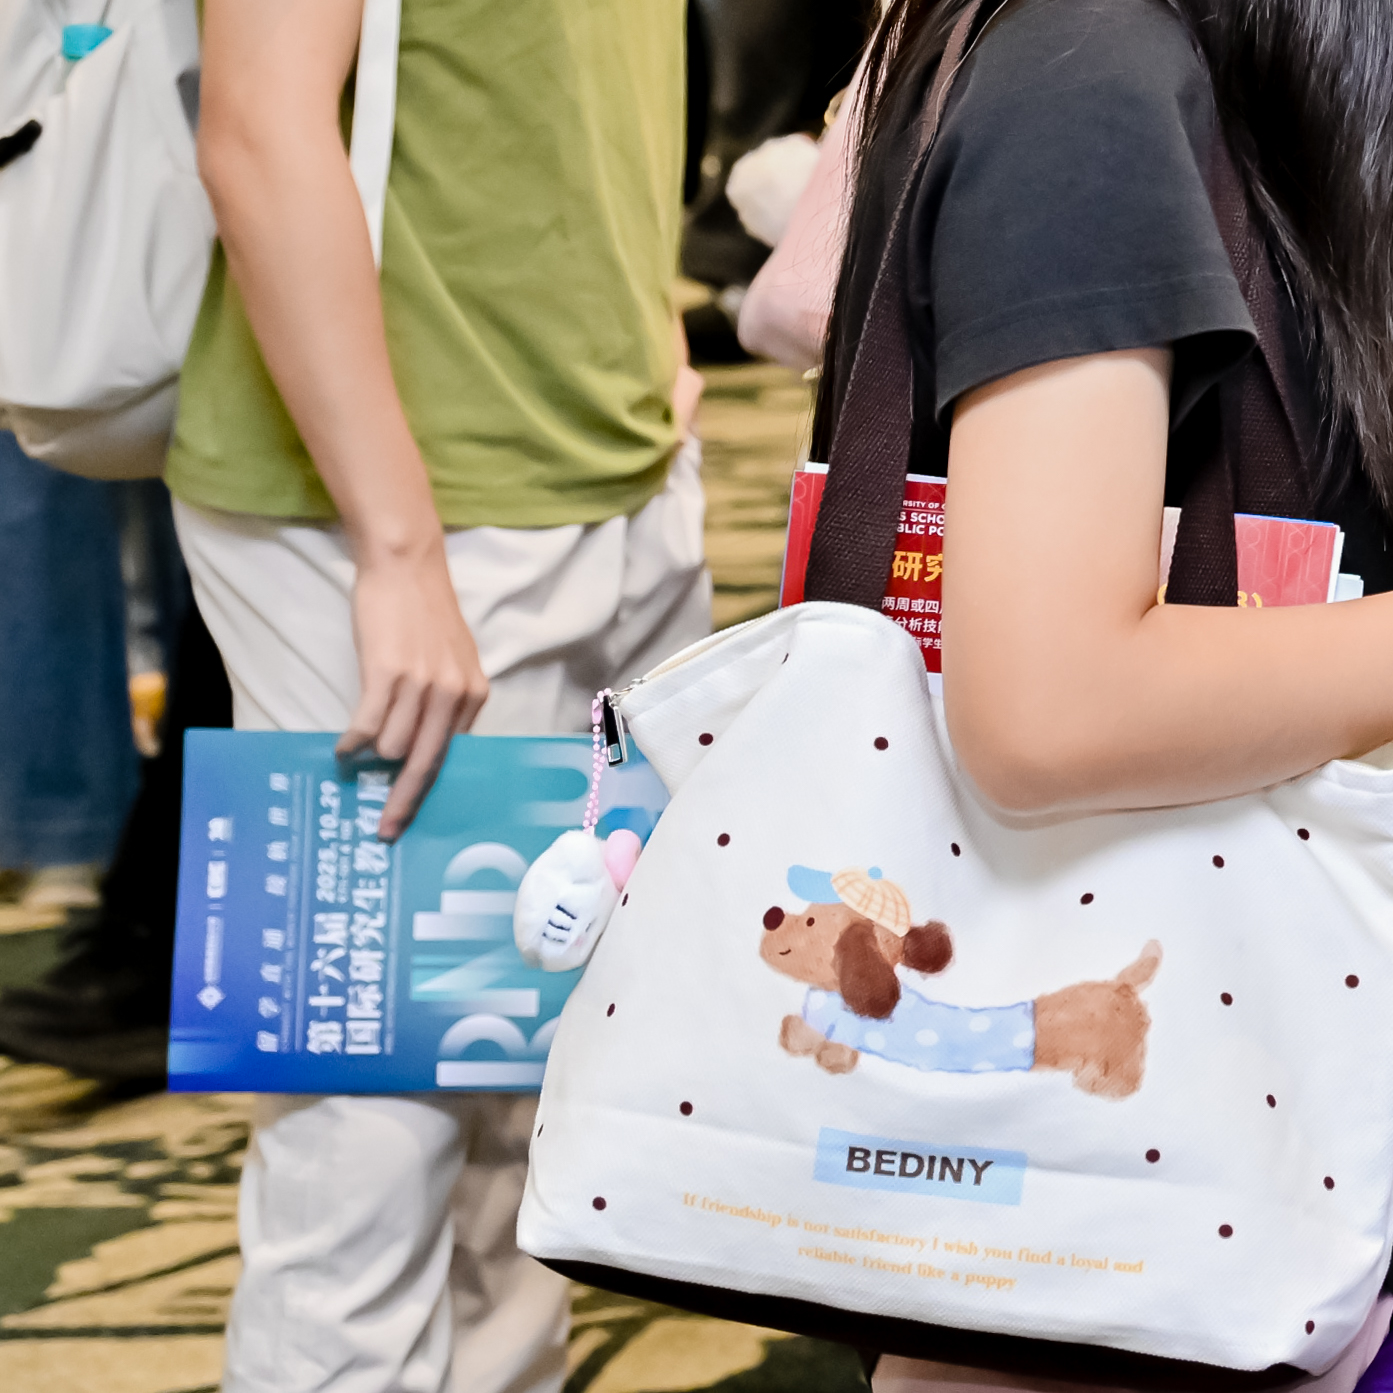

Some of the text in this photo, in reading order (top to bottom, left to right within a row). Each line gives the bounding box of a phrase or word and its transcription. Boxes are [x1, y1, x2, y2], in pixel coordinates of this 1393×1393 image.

[307, 911, 349, 1055] 第十六届
[845, 1145, 994, 1186] BEDINY
[702, 1197, 782, 1227] friendship
[834, 1223, 927, 1252] satisfactory
[943, 1239, 978, 1257] wish
[983, 1246, 1014, 1262] you
[1070, 1253, 1109, 1274] loyal
[798, 1246, 857, 1266] reliable
[862, 1255, 912, 1276] friend
[918, 1263, 945, 1280] like
[964, 1273, 1017, 1292] puppy
